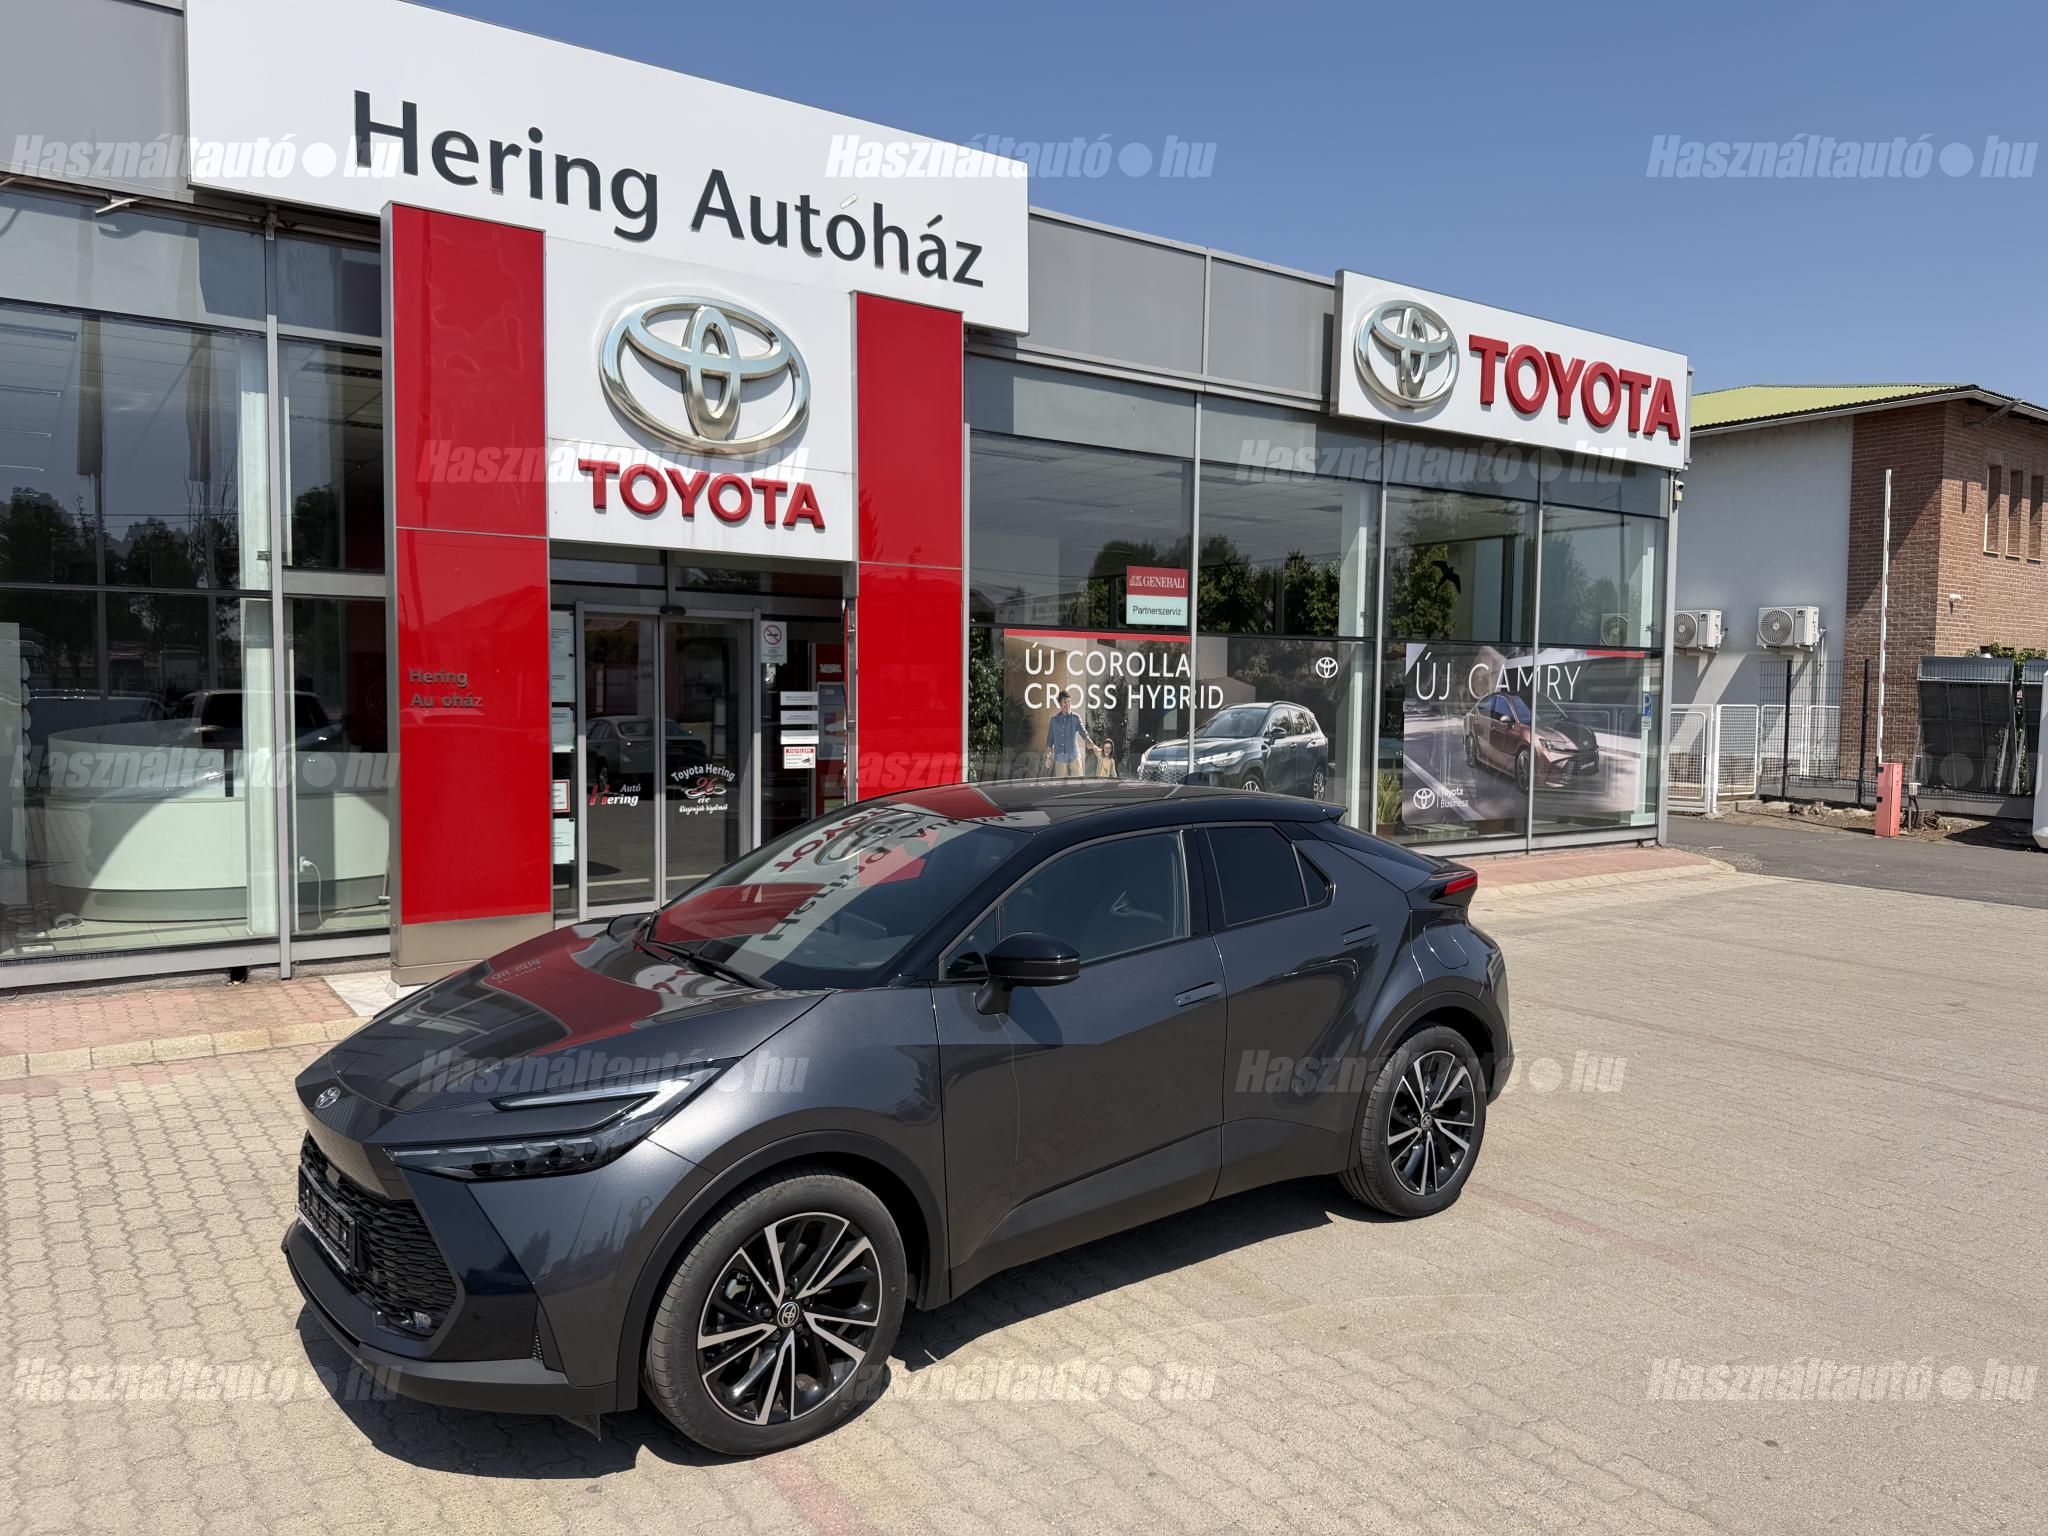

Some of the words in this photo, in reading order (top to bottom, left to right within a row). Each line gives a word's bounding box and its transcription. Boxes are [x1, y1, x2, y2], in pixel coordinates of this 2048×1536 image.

[354, 90, 657, 241] Hering
[690, 169, 984, 288] Autóház
[1469, 334, 1681, 441] TOYOTA
[578, 457, 826, 530] TOYOTA
[1142, 576, 1185, 589] GENERALI
[1132, 605, 1182, 616] Partnerszerviz
[1025, 642, 1056, 676] ÚJ
[1066, 648, 1191, 678] COROLLA
[408, 667, 468, 688] Hering
[1416, 652, 1451, 701] ÚJ
[1469, 664, 1582, 701] CAMRY
[1024, 682, 1118, 711] CROSS
[1128, 684, 1225, 711] HYBRID
[671, 765, 704, 781] Toyota
[705, 763, 736, 782] Hering
[620, 783, 641, 792] Autó
